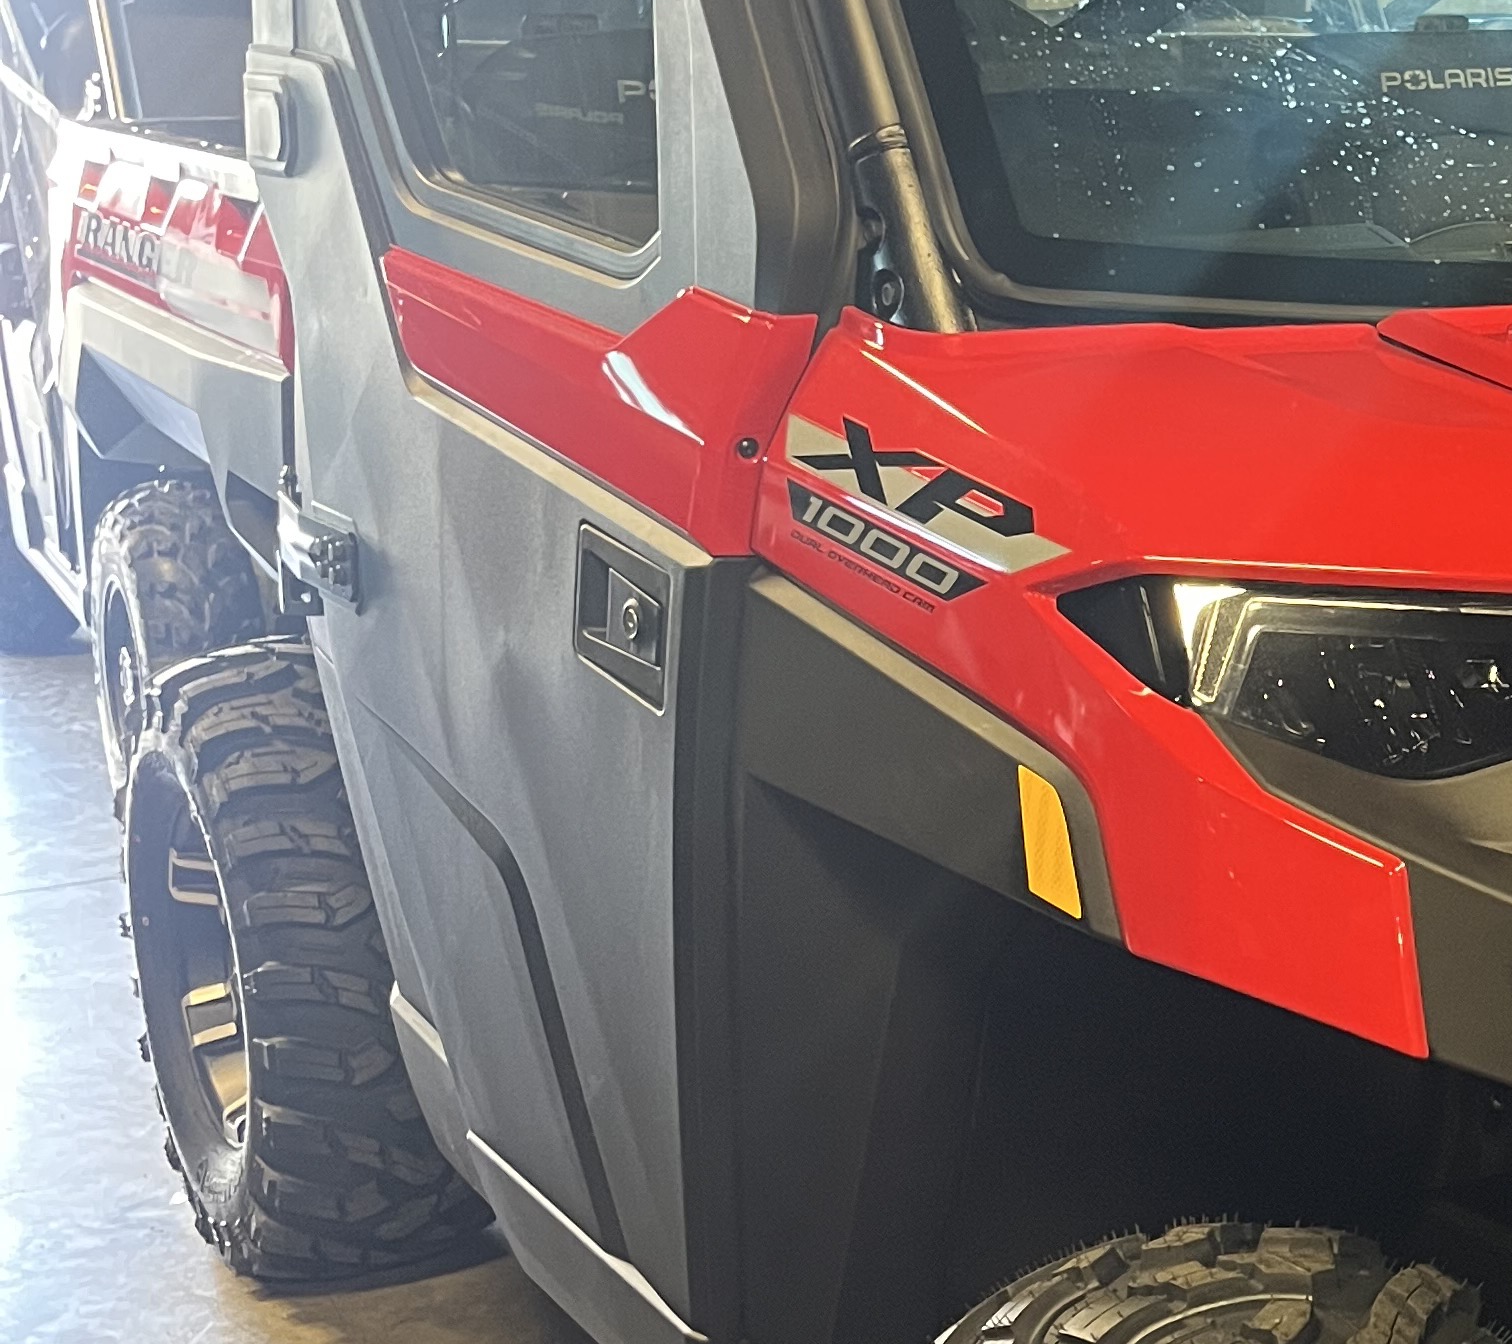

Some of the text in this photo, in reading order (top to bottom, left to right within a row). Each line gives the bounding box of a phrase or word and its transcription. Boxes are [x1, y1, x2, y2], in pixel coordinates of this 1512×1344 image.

[78, 210, 197, 286] RANGER
[791, 414, 1035, 538] XP
[790, 529, 937, 614] DUAL OVERHEAD CAM
[801, 495, 960, 596] 1000
